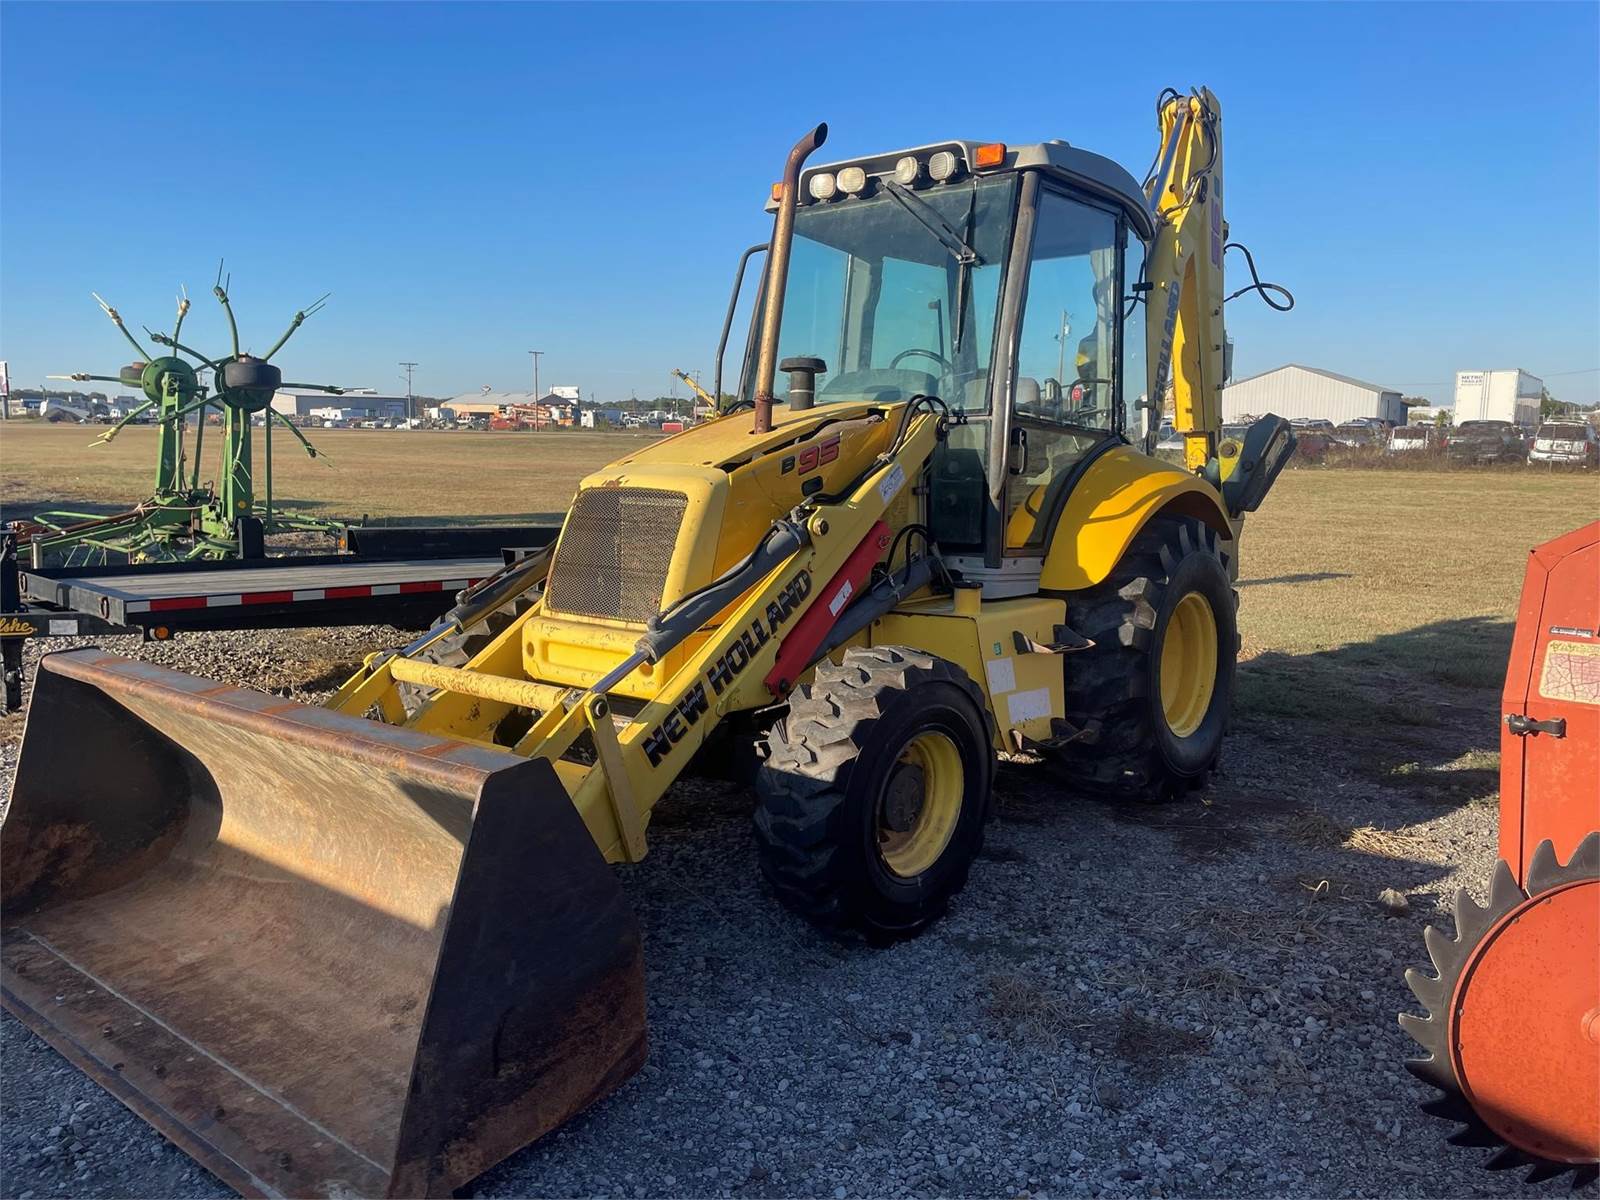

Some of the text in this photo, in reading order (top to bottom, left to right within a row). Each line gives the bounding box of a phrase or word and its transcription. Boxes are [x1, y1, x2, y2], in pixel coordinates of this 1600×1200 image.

[1152, 281, 1179, 402] HOLLAND
[641, 569, 812, 768] NEW HOLLAND
